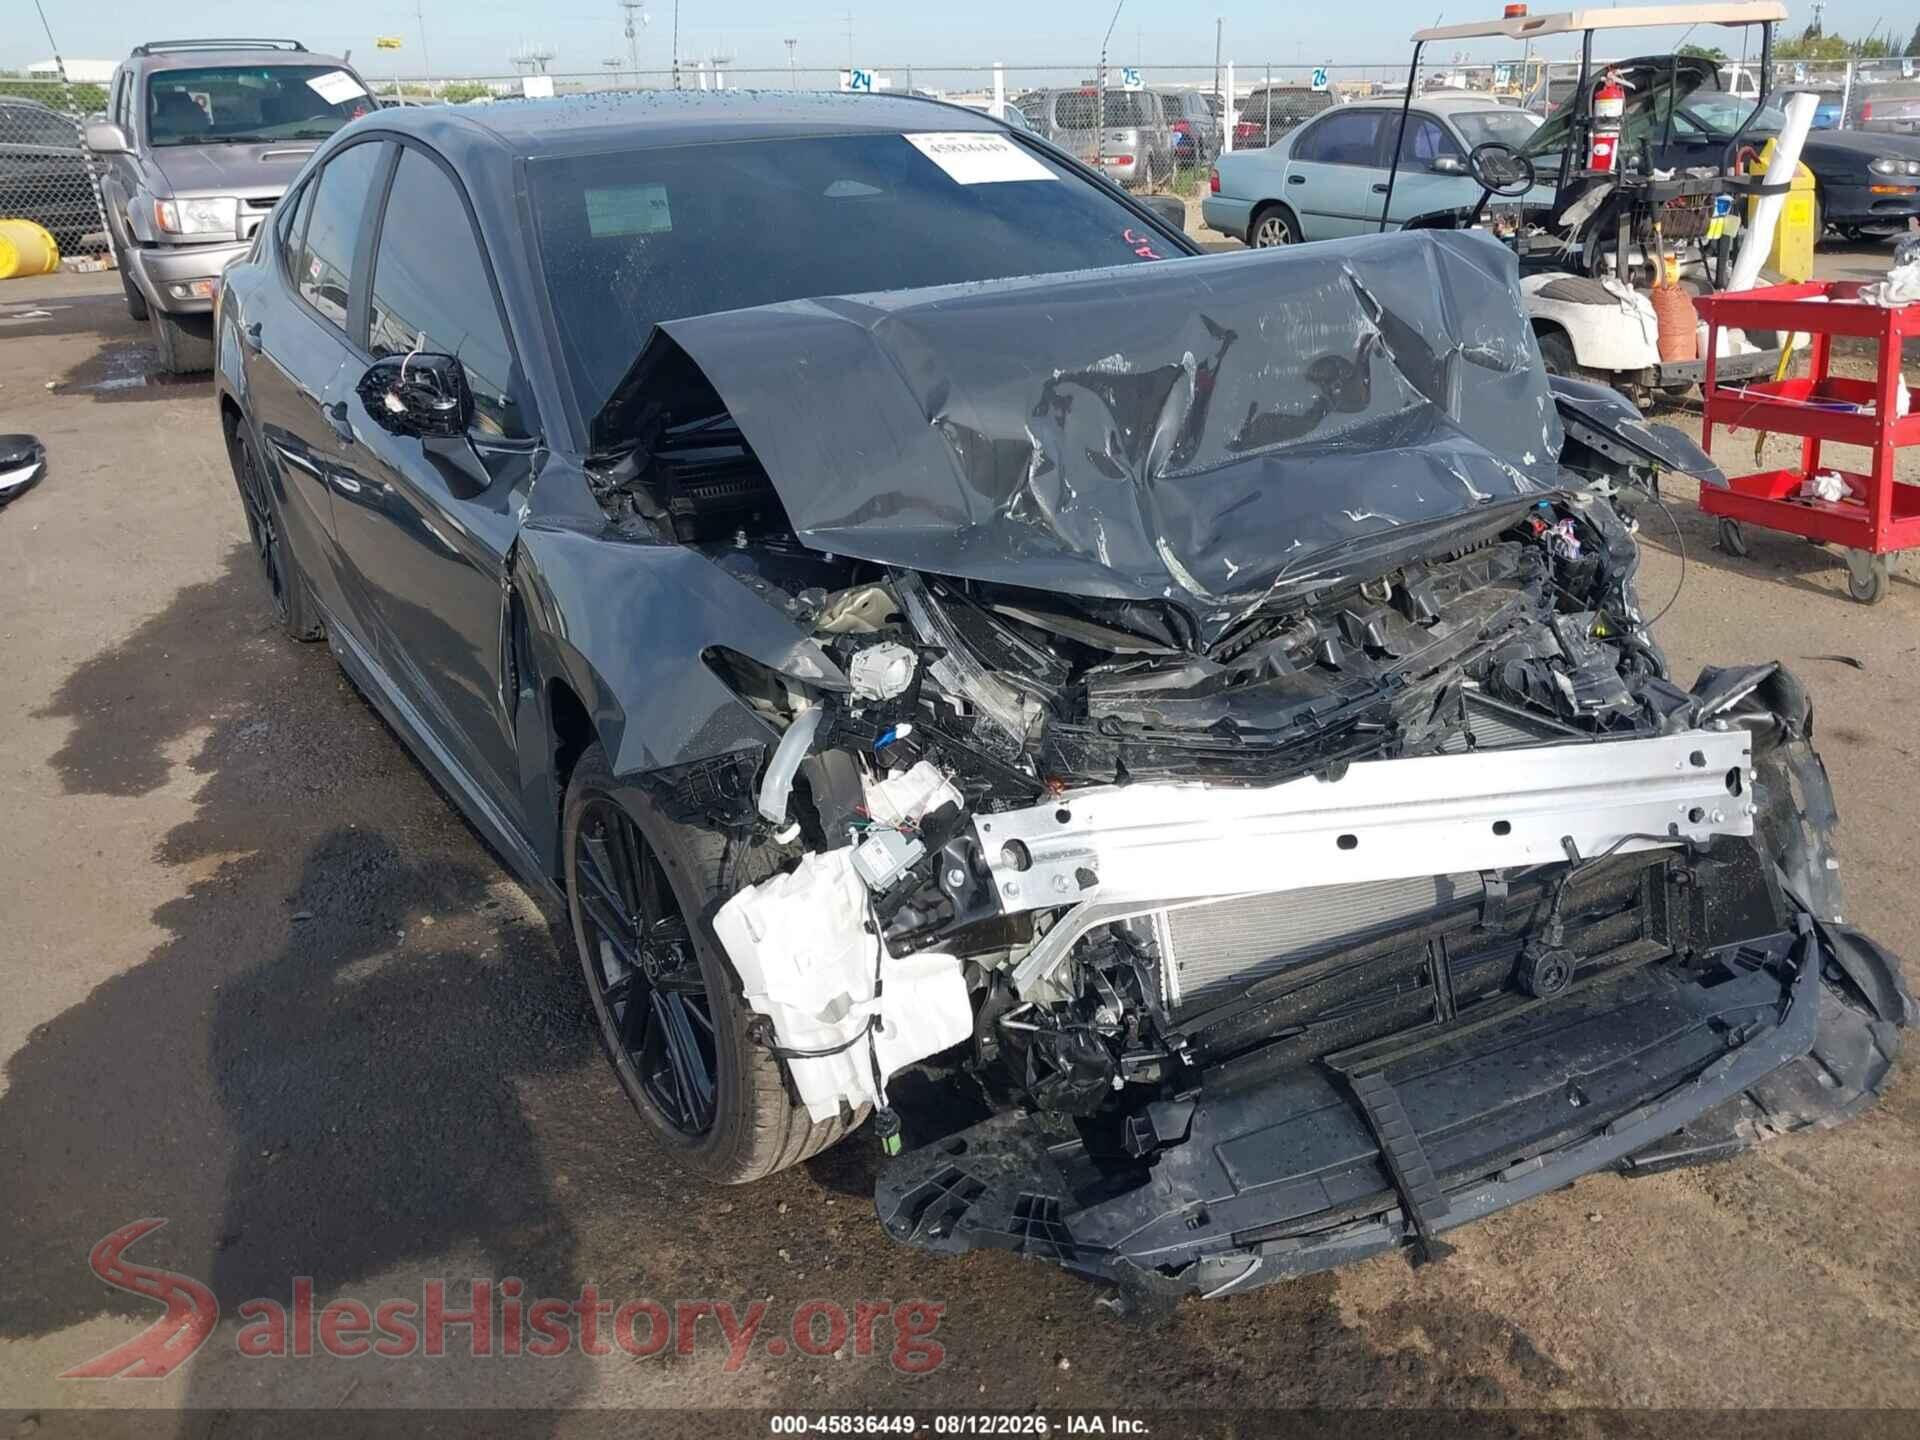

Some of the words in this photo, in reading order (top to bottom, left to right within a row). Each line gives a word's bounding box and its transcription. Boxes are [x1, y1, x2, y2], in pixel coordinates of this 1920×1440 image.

[851, 70, 871, 92] 24
[1123, 67, 1140, 86] 25
[1313, 66, 1327, 86] 26
